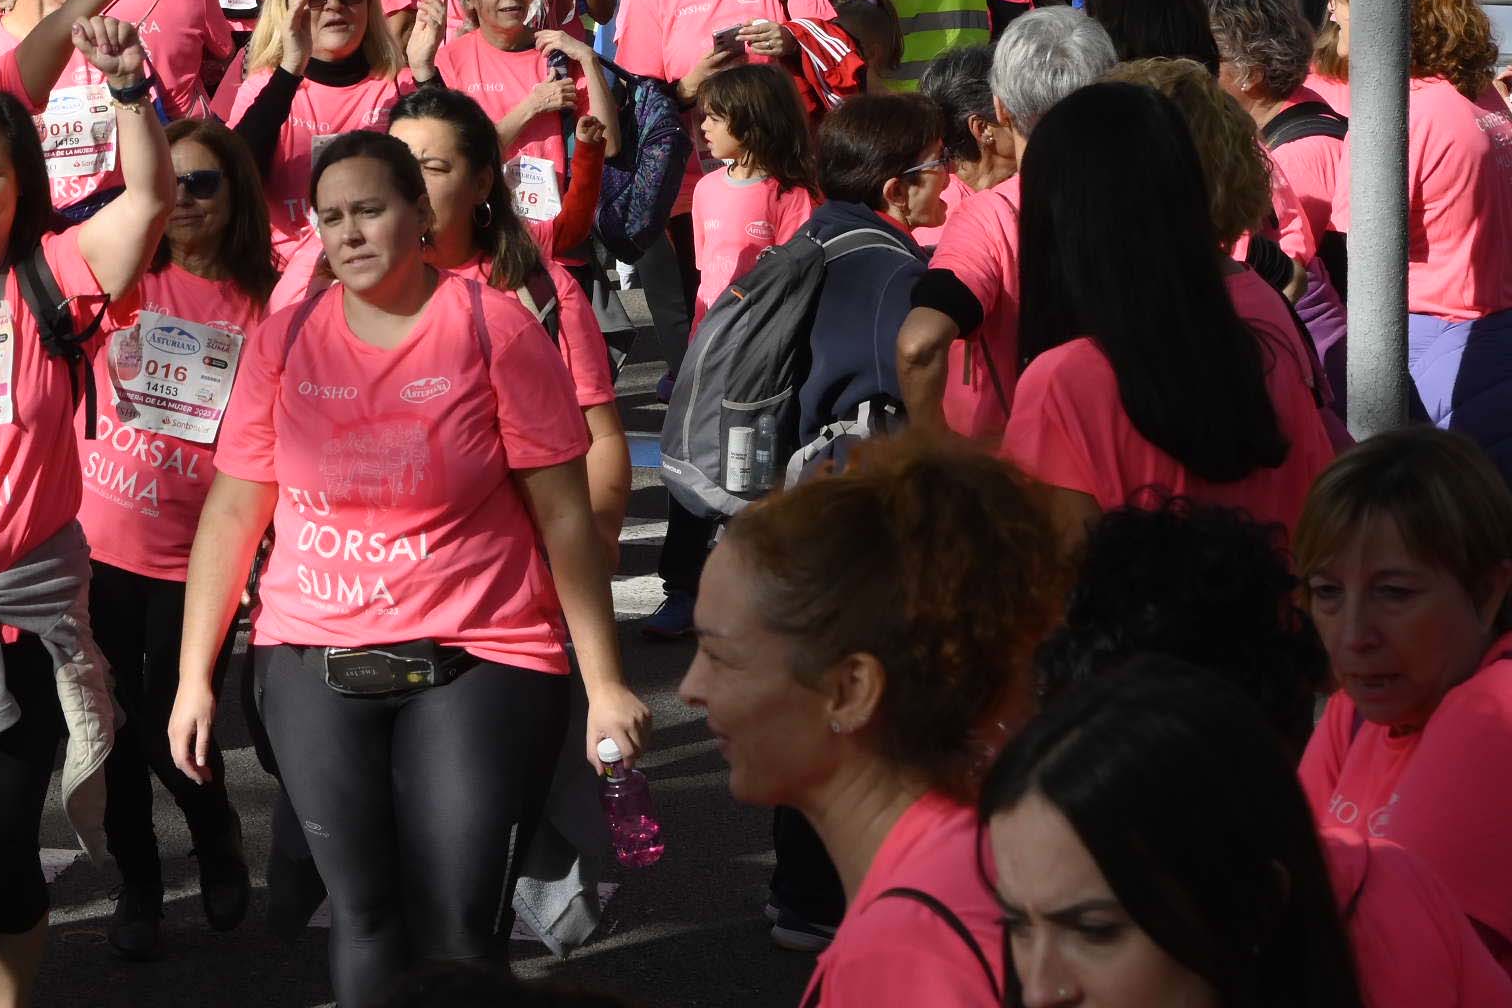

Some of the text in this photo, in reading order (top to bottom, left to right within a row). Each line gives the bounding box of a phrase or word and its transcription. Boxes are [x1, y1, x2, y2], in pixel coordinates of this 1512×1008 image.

[50, 120, 84, 136] 016
[518, 190, 539, 205] 16
[150, 332, 197, 352] ASTURIANA
[145, 359, 188, 382] 016
[146, 381, 179, 397] 14153
[298, 380, 358, 400] OYSHO
[145, 397, 156, 405] DE
[156, 399, 167, 407] LA
[167, 401, 193, 413] MUJER
[97, 415, 200, 480] DORSAL
[83, 451, 159, 507] SUMA
[288, 486, 331, 516] TU
[297, 520, 430, 563] DORSAL
[296, 563, 396, 607] SUMA
